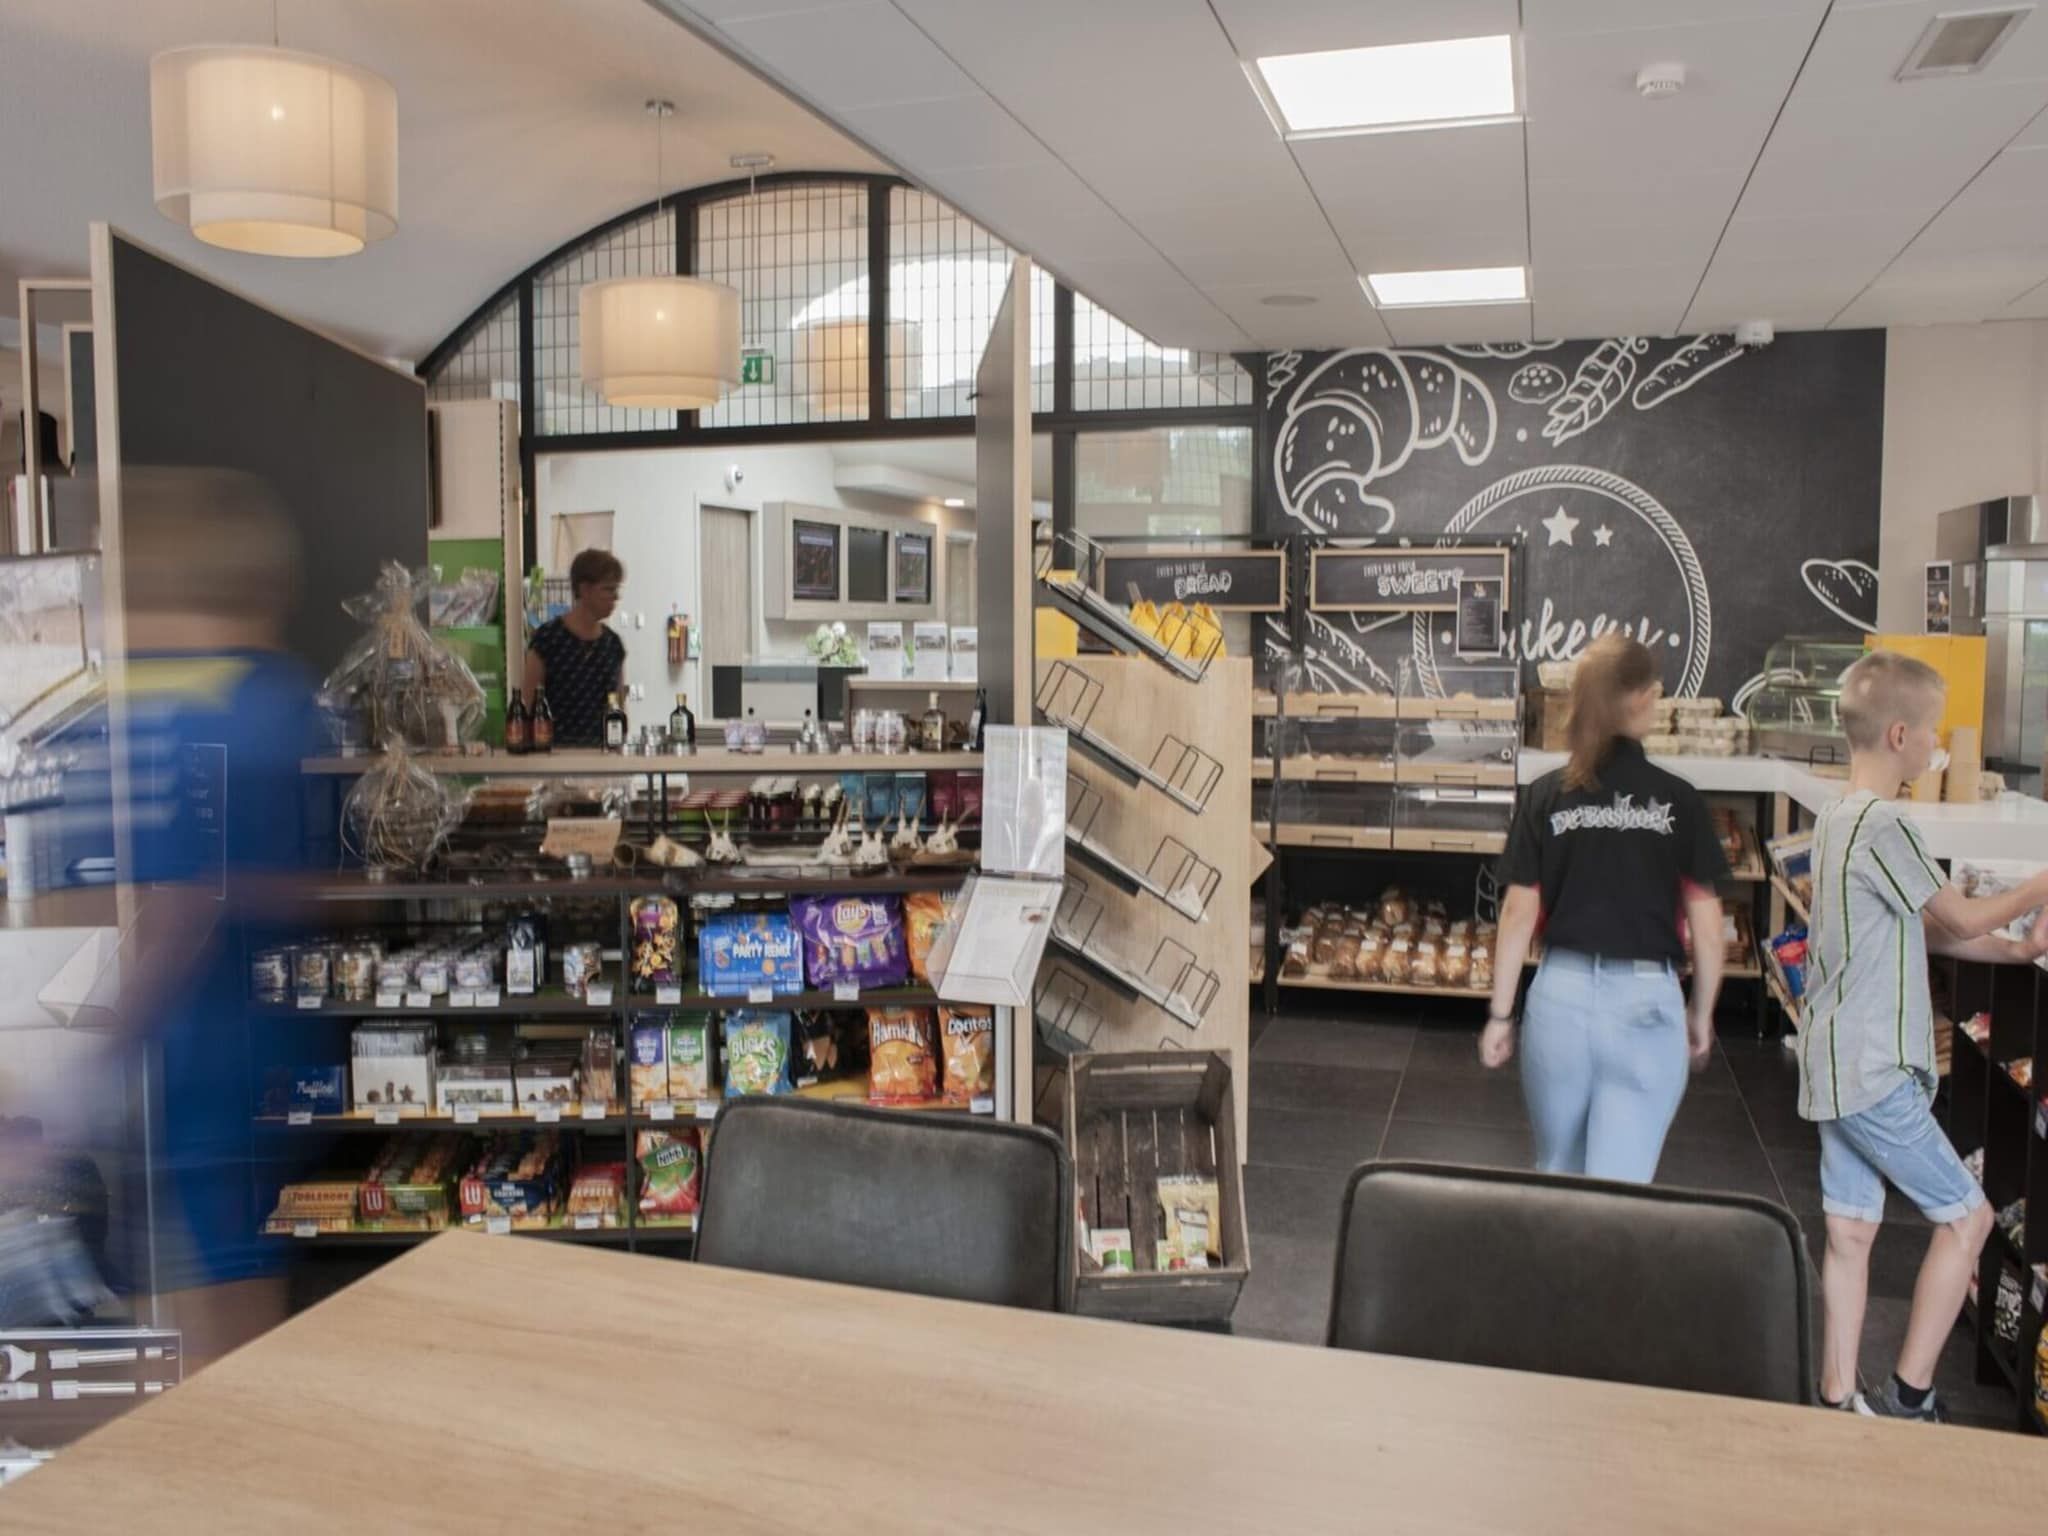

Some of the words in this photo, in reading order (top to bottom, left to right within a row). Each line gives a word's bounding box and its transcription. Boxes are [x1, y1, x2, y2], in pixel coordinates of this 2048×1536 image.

[1174, 569, 1232, 599] BREAD
[1377, 566, 1464, 597] SWEETS
[732, 942, 762, 959] PARTY
[366, 1190, 382, 1210] LU
[465, 1184, 481, 1206] LU
